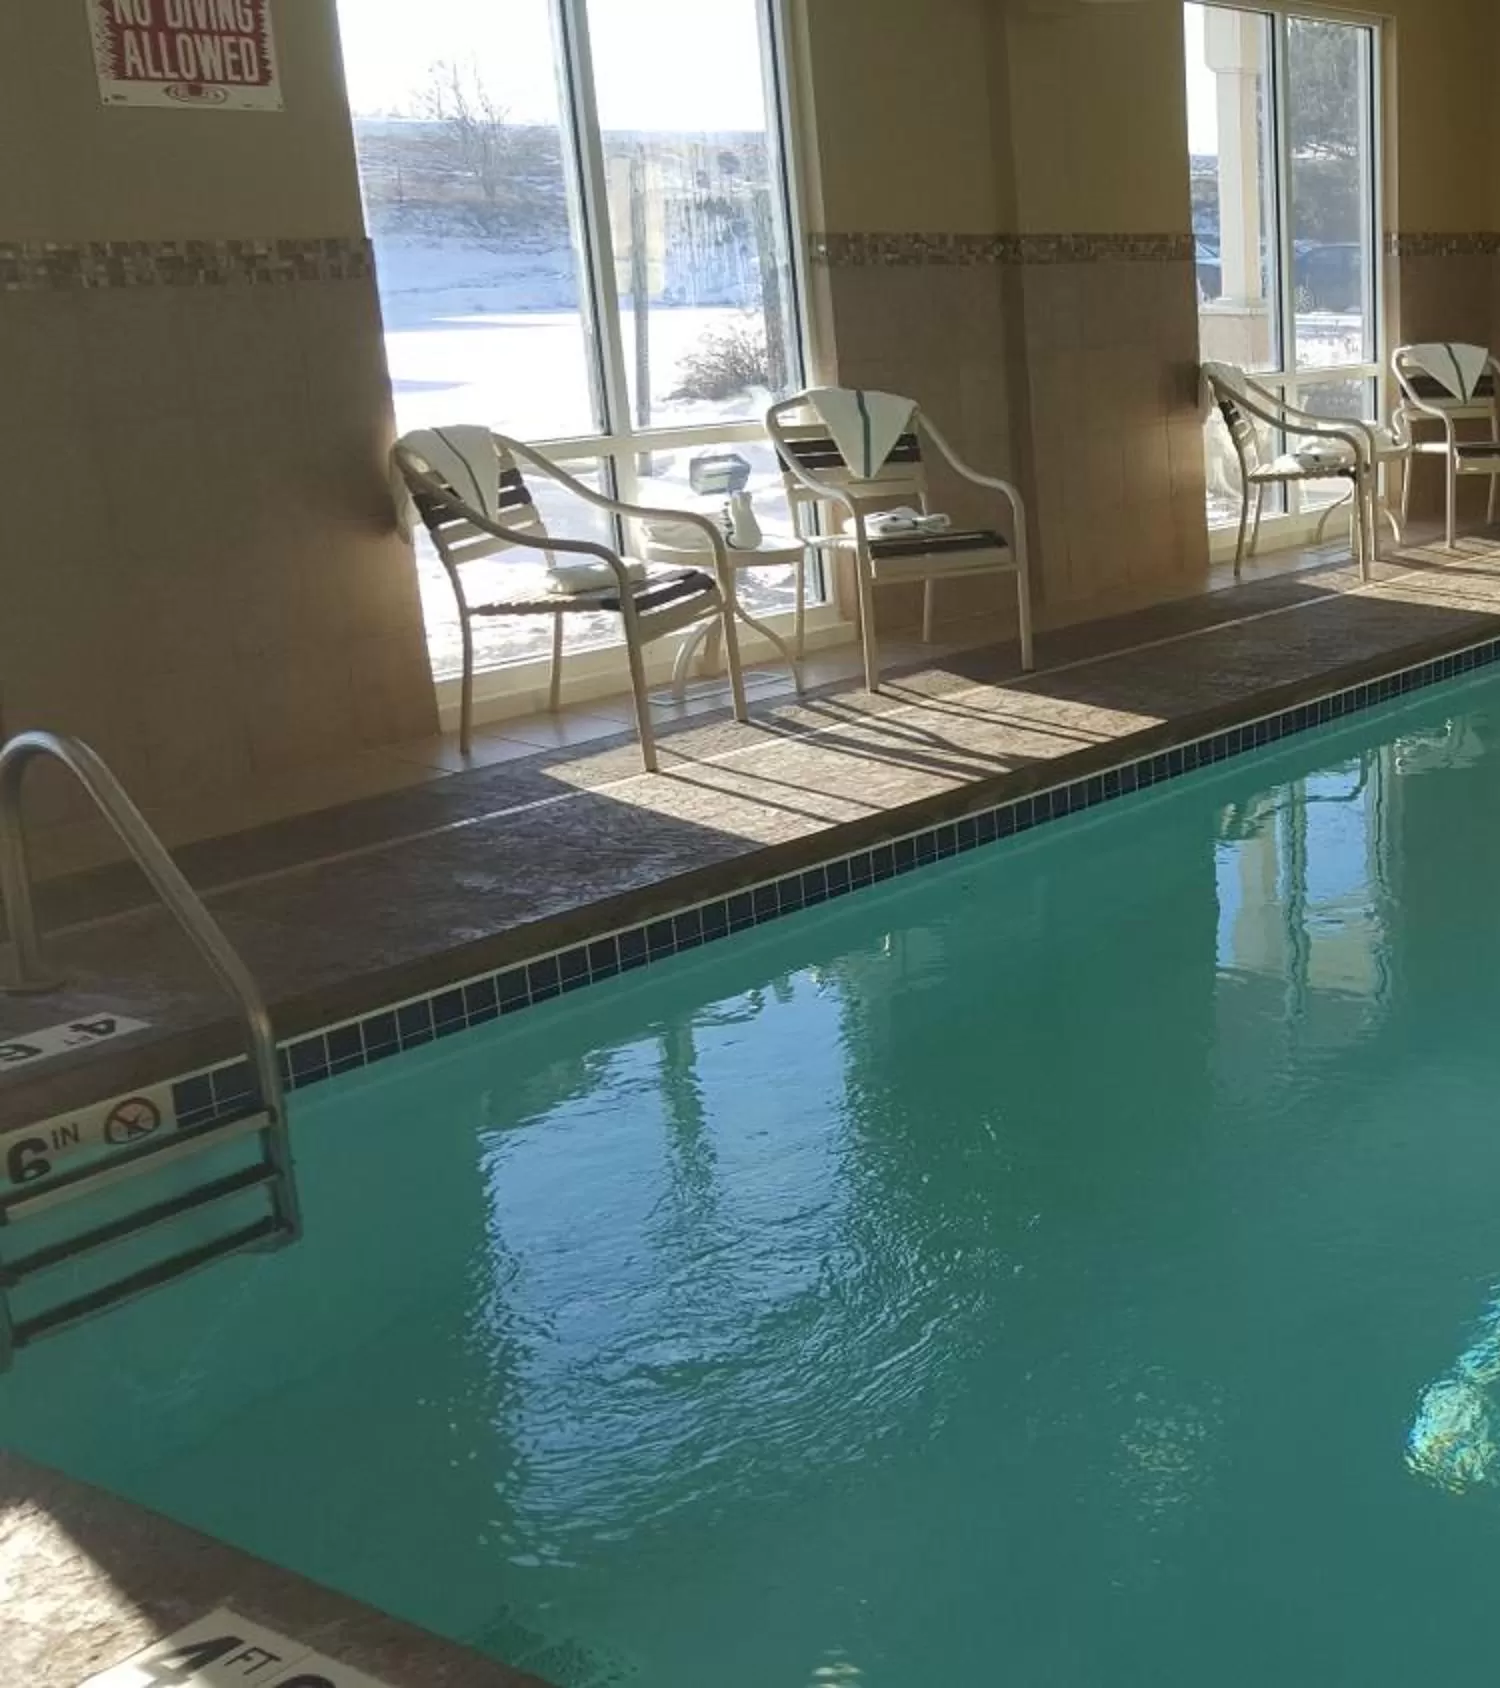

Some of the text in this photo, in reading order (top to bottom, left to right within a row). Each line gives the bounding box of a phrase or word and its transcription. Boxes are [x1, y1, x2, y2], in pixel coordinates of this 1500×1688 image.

[112, 0, 254, 33] NO DIVING
[122, 29, 260, 82] ALLOWED
[51, 1122, 81, 1150] IN
[223, 1646, 283, 1676] FT
